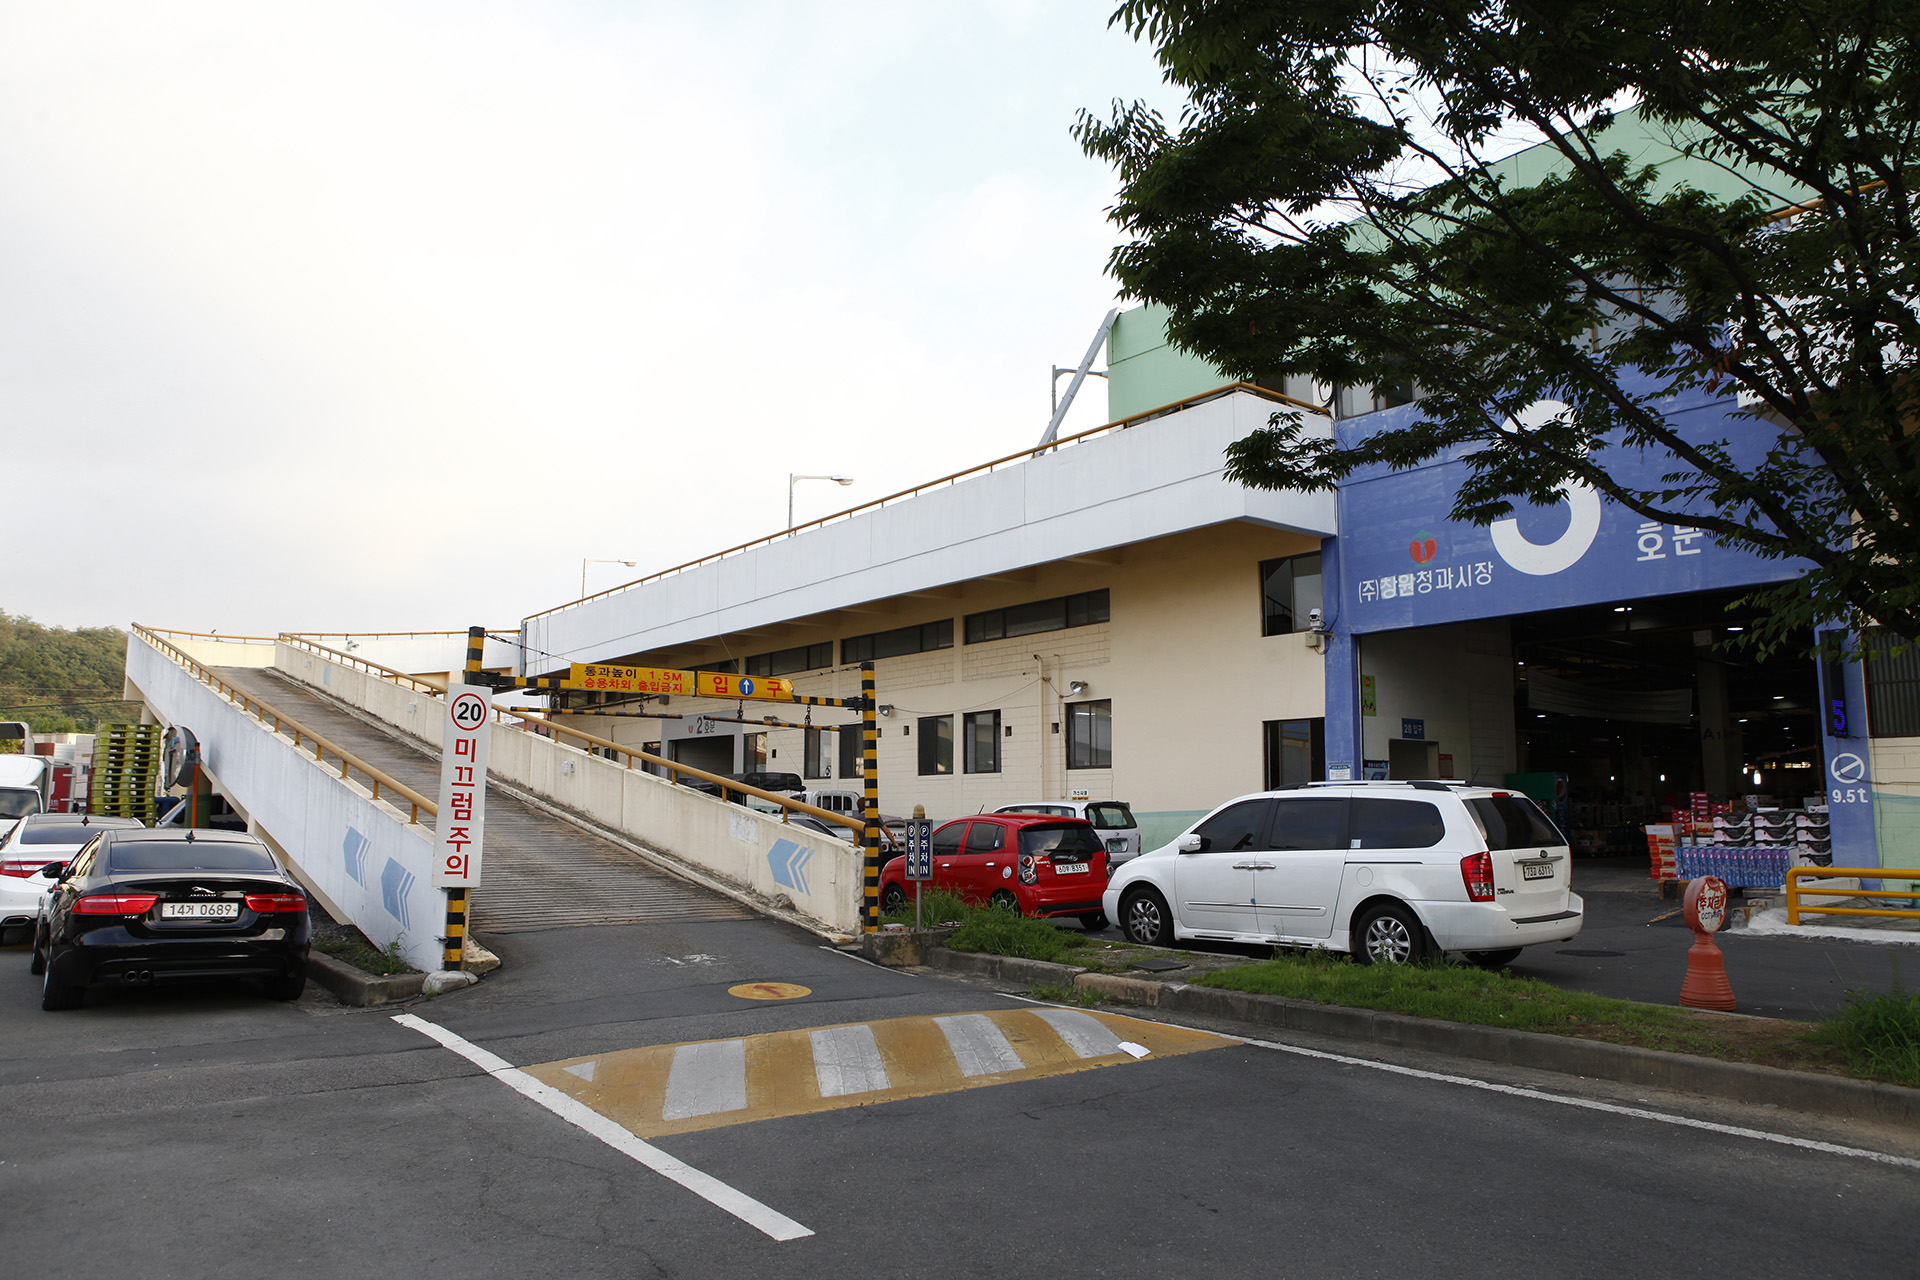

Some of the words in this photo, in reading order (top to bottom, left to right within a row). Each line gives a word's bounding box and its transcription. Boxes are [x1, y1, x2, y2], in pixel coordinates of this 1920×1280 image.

[584, 666, 637, 678] 통과높이
[650, 671, 682, 681] 1.5M
[584, 677, 631, 690] 승용차외
[637, 680, 683, 693] 출입금지
[713, 675, 728, 694] 입
[766, 681, 783, 697] 구
[457, 702, 482, 722] 20
[1832, 788, 1868, 803] 9.5t
[920, 839, 929, 863] 주차
[919, 865, 929, 875] IN
[200, 904, 232, 916] 0689
